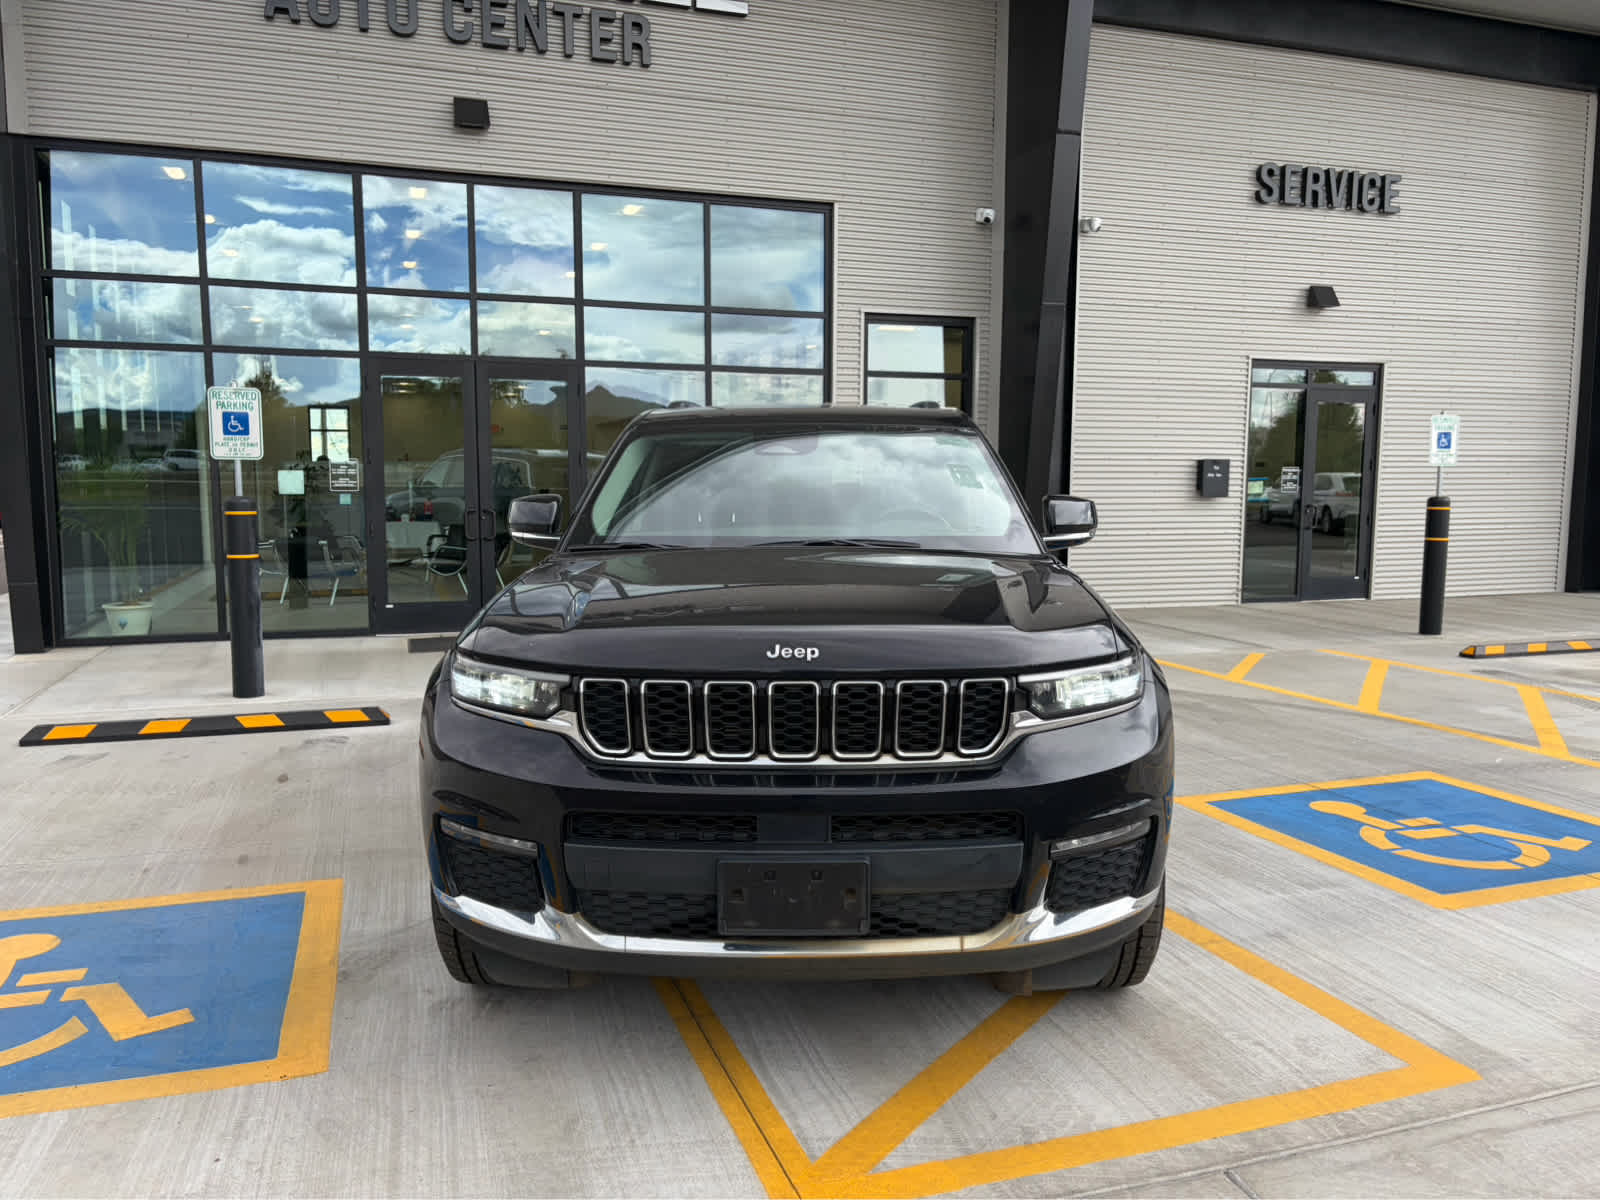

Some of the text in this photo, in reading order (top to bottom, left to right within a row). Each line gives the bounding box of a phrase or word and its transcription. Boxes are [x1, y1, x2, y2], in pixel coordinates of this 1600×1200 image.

[443, 0, 651, 68] CENTER
[1255, 162, 1402, 214] SERVICE
[211, 390, 257, 401] RESERVED
[215, 400, 254, 411] PARKING
[766, 644, 820, 661] Jeep
